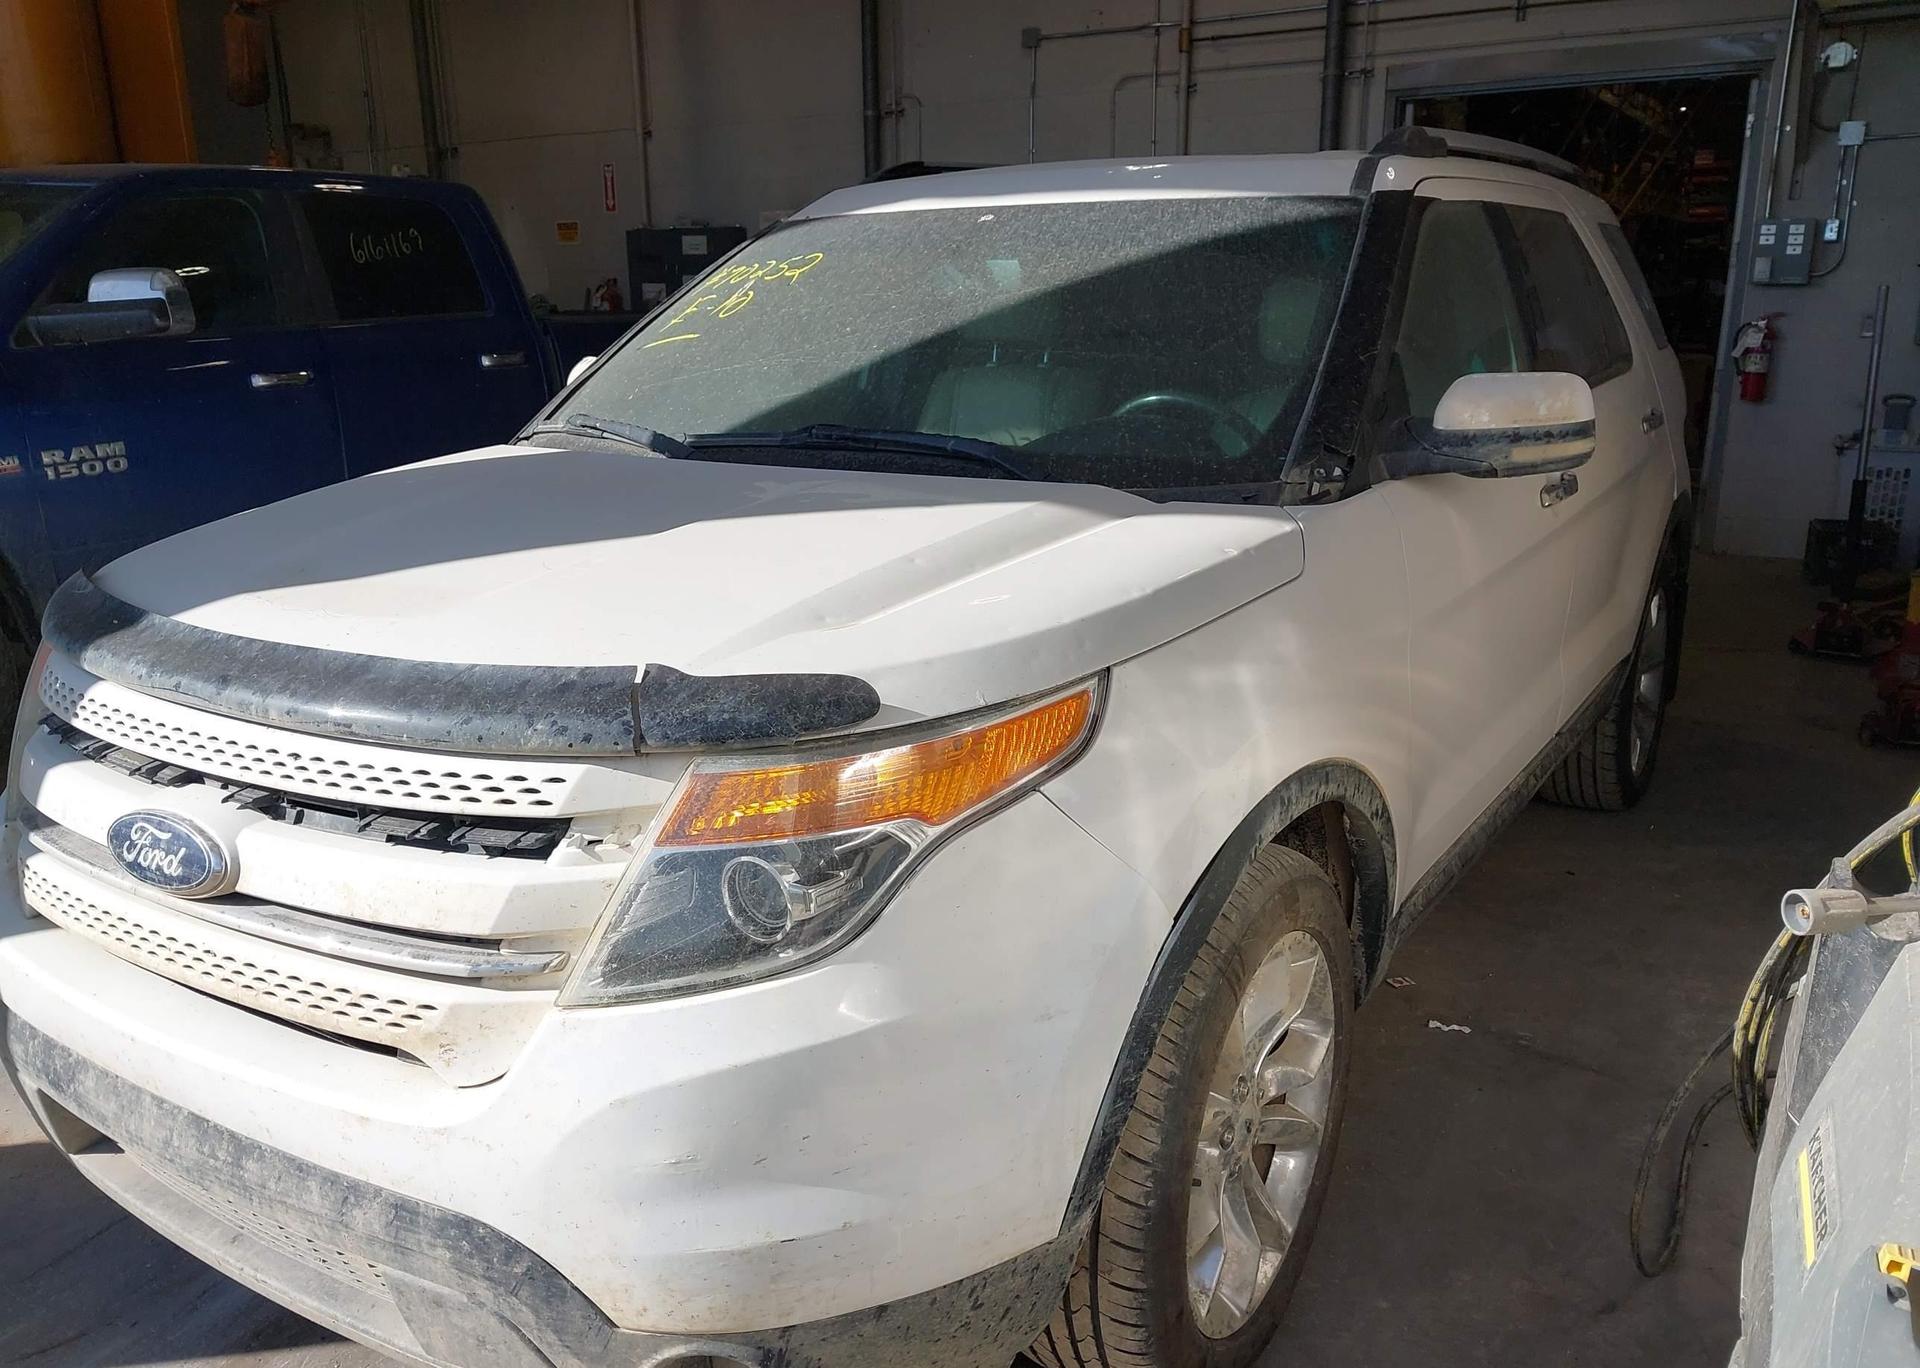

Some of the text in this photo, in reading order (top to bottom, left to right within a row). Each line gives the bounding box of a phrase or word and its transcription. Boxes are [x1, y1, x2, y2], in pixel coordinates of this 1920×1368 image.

[41, 441, 126, 465] RAM
[44, 457, 128, 480] 1500
[122, 822, 187, 877] Ford
[1808, 1126, 1829, 1250] KÄRCHER
